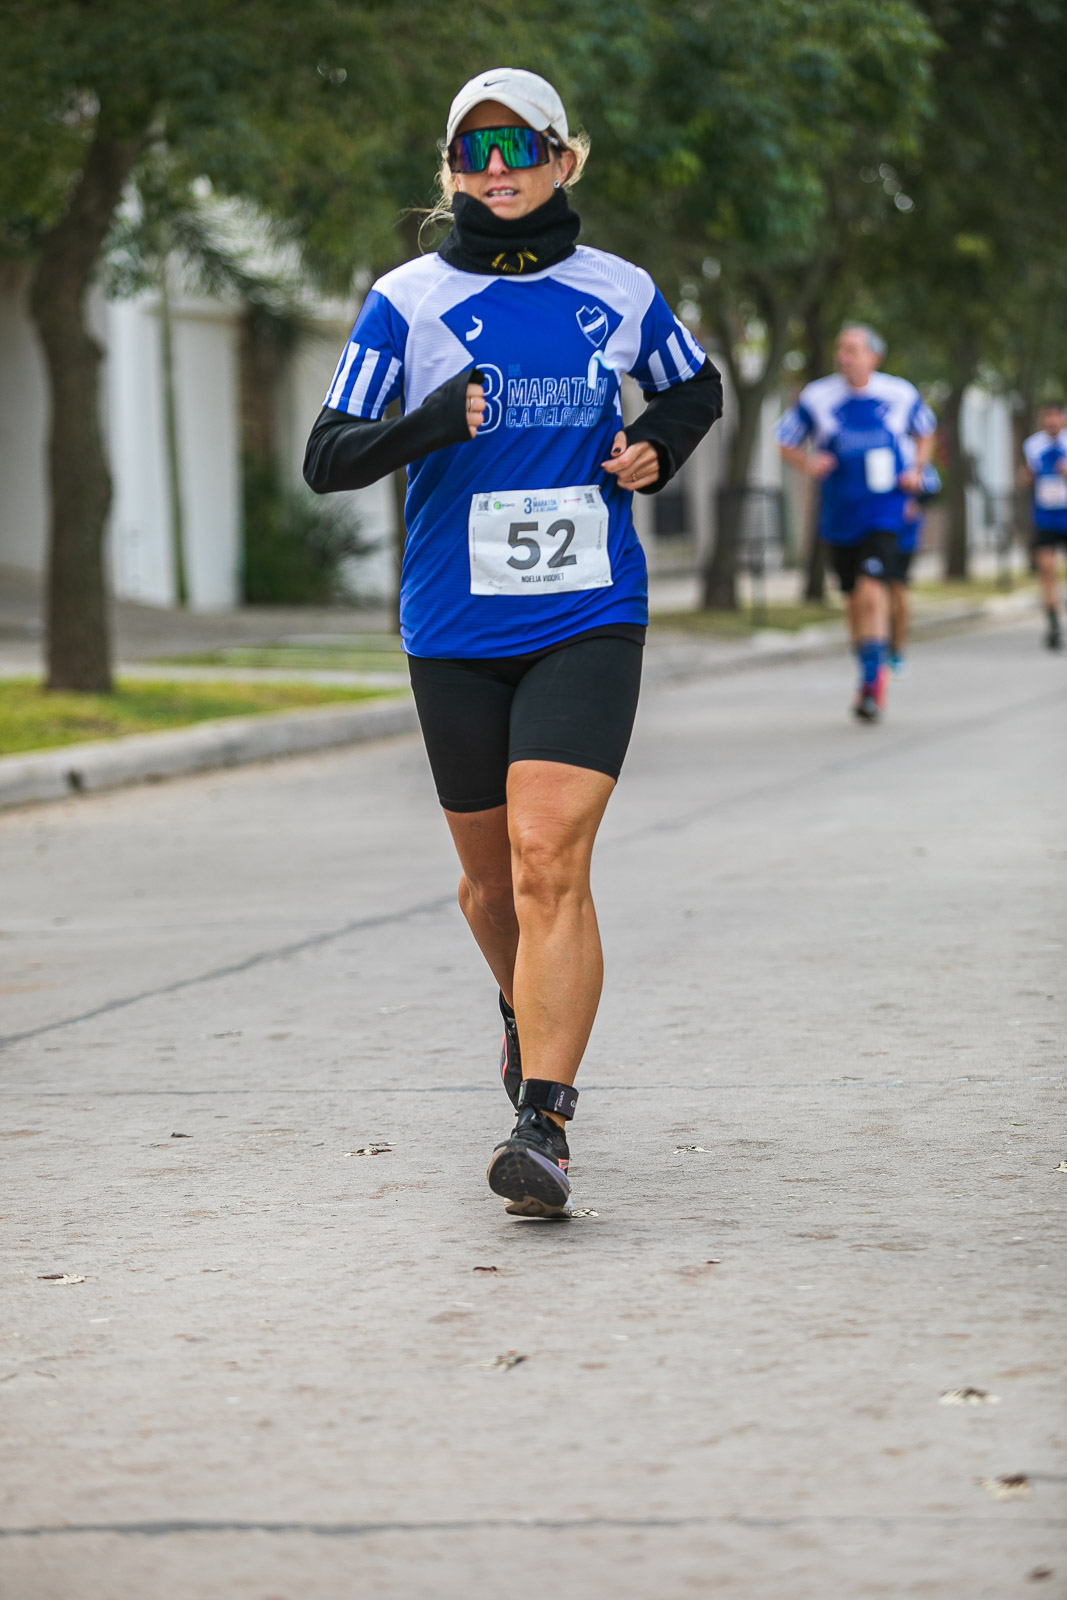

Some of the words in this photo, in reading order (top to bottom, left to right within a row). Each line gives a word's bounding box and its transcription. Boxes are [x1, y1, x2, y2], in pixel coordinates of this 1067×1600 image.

[524, 497, 532, 514] 3
[507, 519, 577, 570] 52
[522, 574, 541, 582] NOELIA
